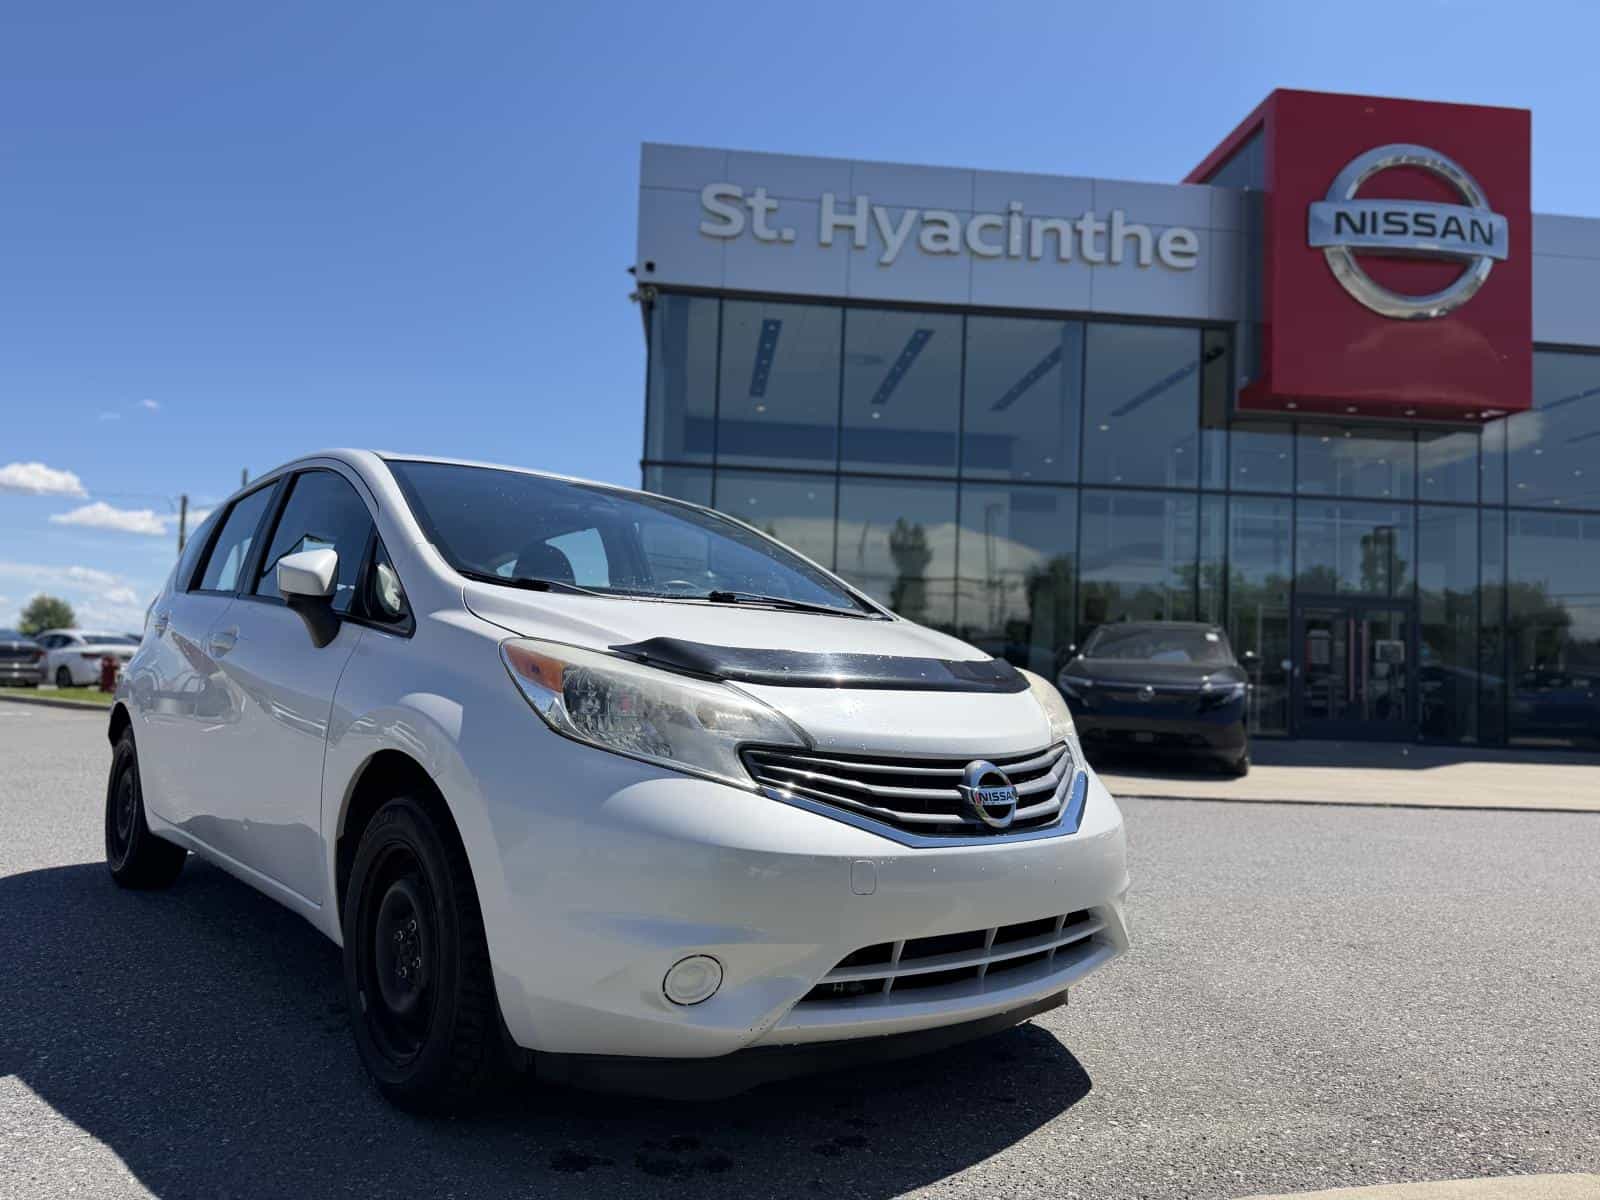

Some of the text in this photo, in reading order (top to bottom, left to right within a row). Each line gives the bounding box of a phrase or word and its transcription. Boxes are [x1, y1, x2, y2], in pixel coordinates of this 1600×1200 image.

[699, 182, 1199, 270] St. Hyacinthe
[1333, 210, 1495, 247] NISSAN
